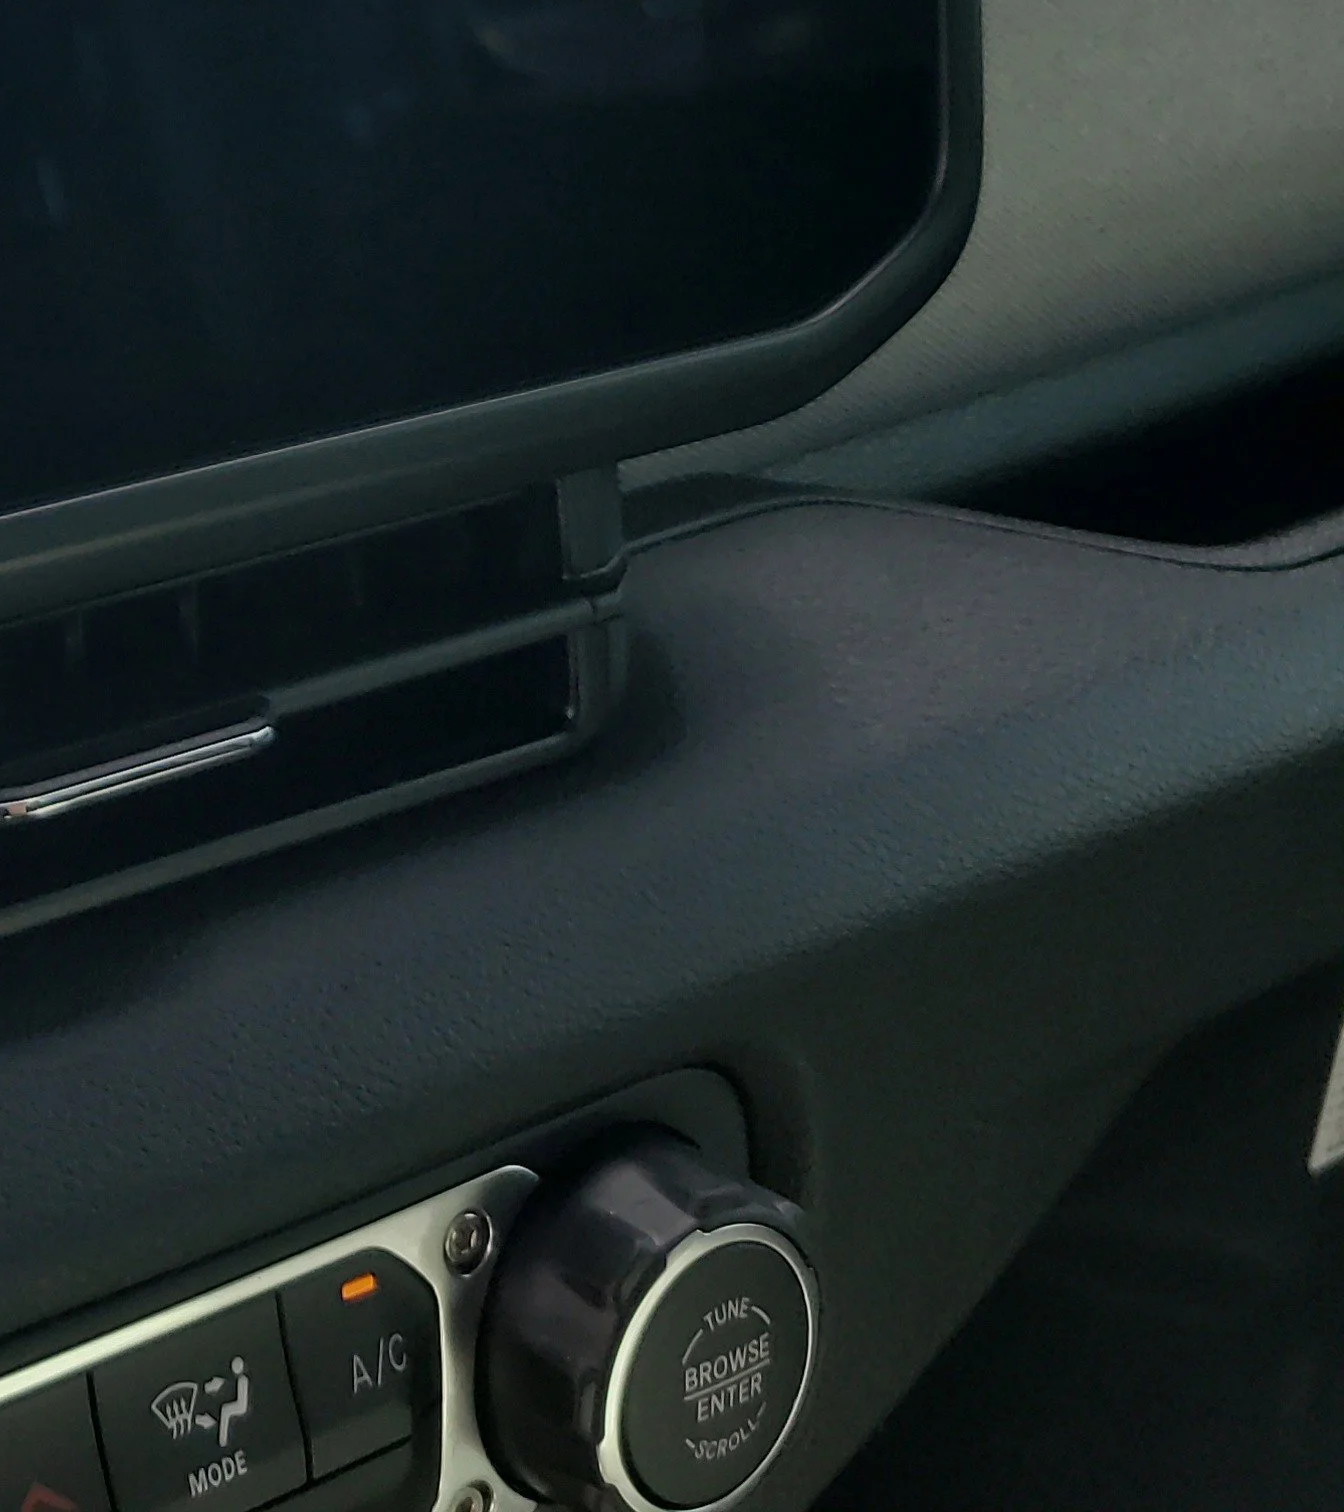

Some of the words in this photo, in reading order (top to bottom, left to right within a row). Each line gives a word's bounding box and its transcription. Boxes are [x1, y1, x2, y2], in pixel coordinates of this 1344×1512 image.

[703, 1297, 750, 1332] TUNE
[353, 1333, 407, 1394] A/C
[685, 1332, 770, 1392] BROWSE
[697, 1372, 762, 1424] ENTER
[694, 1418, 760, 1460] SCROLL
[188, 1449, 249, 1498] MODE
